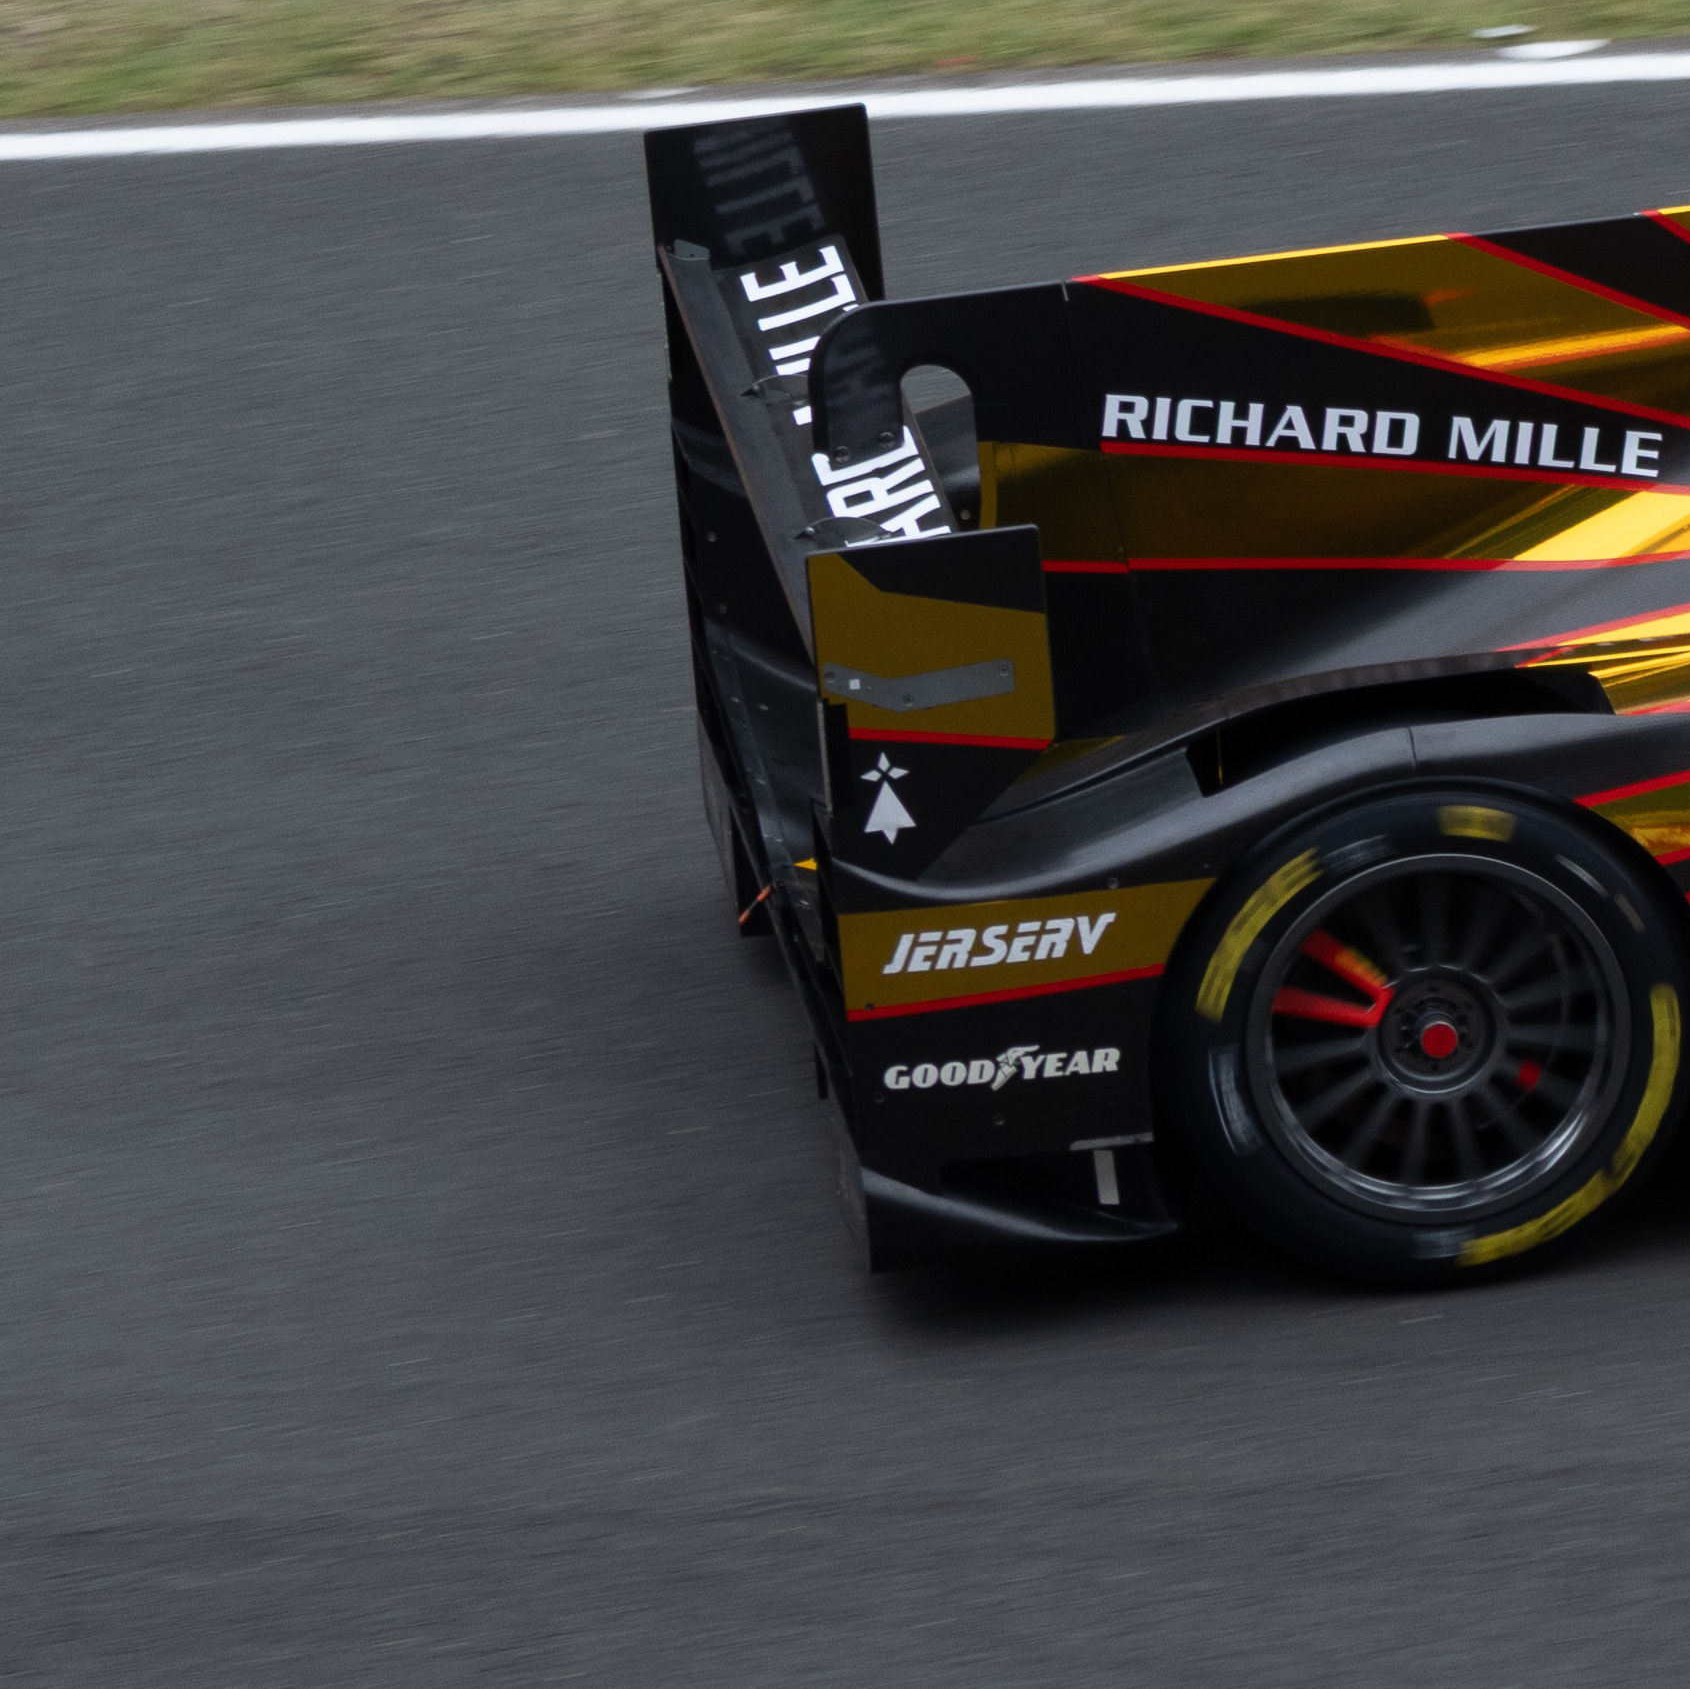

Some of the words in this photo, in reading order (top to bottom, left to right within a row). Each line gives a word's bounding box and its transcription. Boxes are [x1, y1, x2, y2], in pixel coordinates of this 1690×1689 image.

[1102, 394, 1420, 456] RICHARD
[1448, 416, 1663, 478] MILLE
[882, 912, 1117, 975] JERSERV
[884, 1044, 1121, 1091] GOODYEAR
